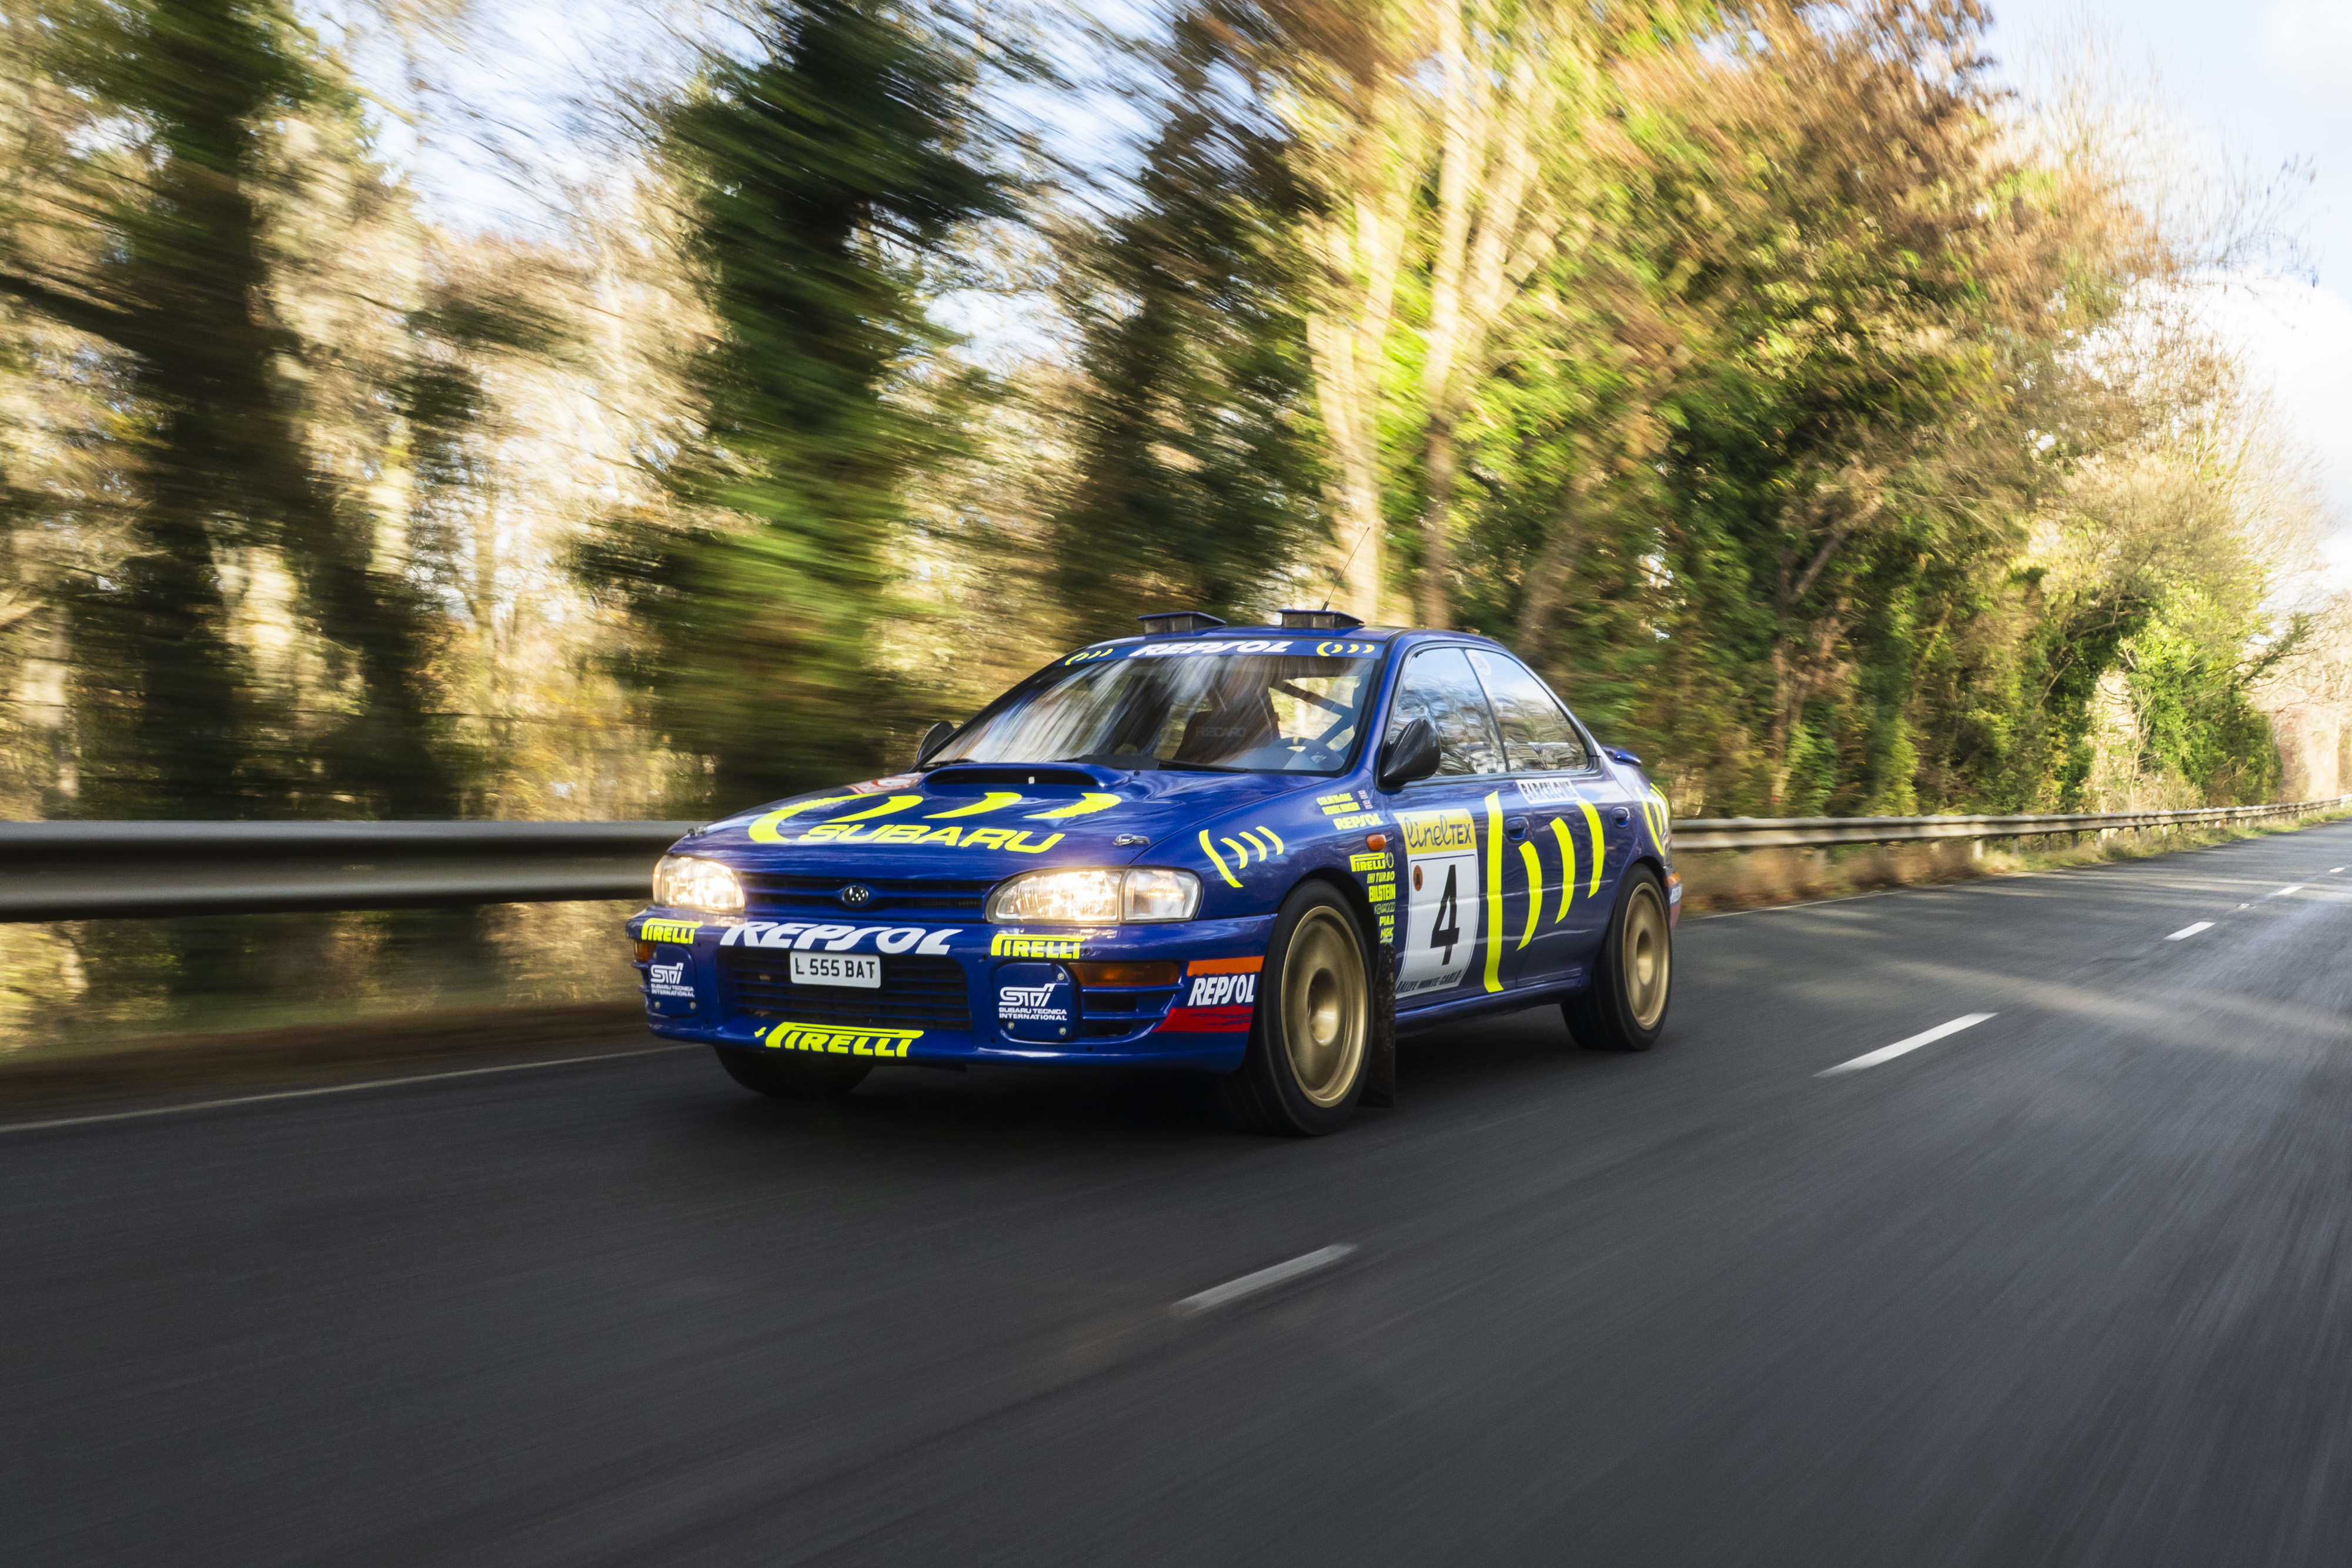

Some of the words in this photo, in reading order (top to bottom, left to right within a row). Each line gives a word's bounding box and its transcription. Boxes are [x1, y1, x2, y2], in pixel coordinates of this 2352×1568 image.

[1128, 641, 1293, 657] REPSOL
[1332, 813, 1383, 830] REPSOL
[798, 824, 1065, 853] SUBARU
[1349, 852, 1386, 872] PIRELLI
[1376, 871, 1395, 883] TURBO
[1369, 884, 1396, 902] BILSTEIN
[1379, 915, 1395, 927] PIAA
[1430, 864, 1460, 966] 4
[642, 918, 703, 944] PIRELLI
[720, 921, 963, 955] REPSOL
[991, 934, 1086, 959] PIRELLI
[795, 958, 804, 975] L
[810, 958, 840, 977] 555
[845, 960, 875, 978] BAT
[652, 989, 695, 998] INTERNATIONAL
[1187, 974, 1255, 1006] REPSOL
[765, 1021, 924, 1057] PIRELLI
